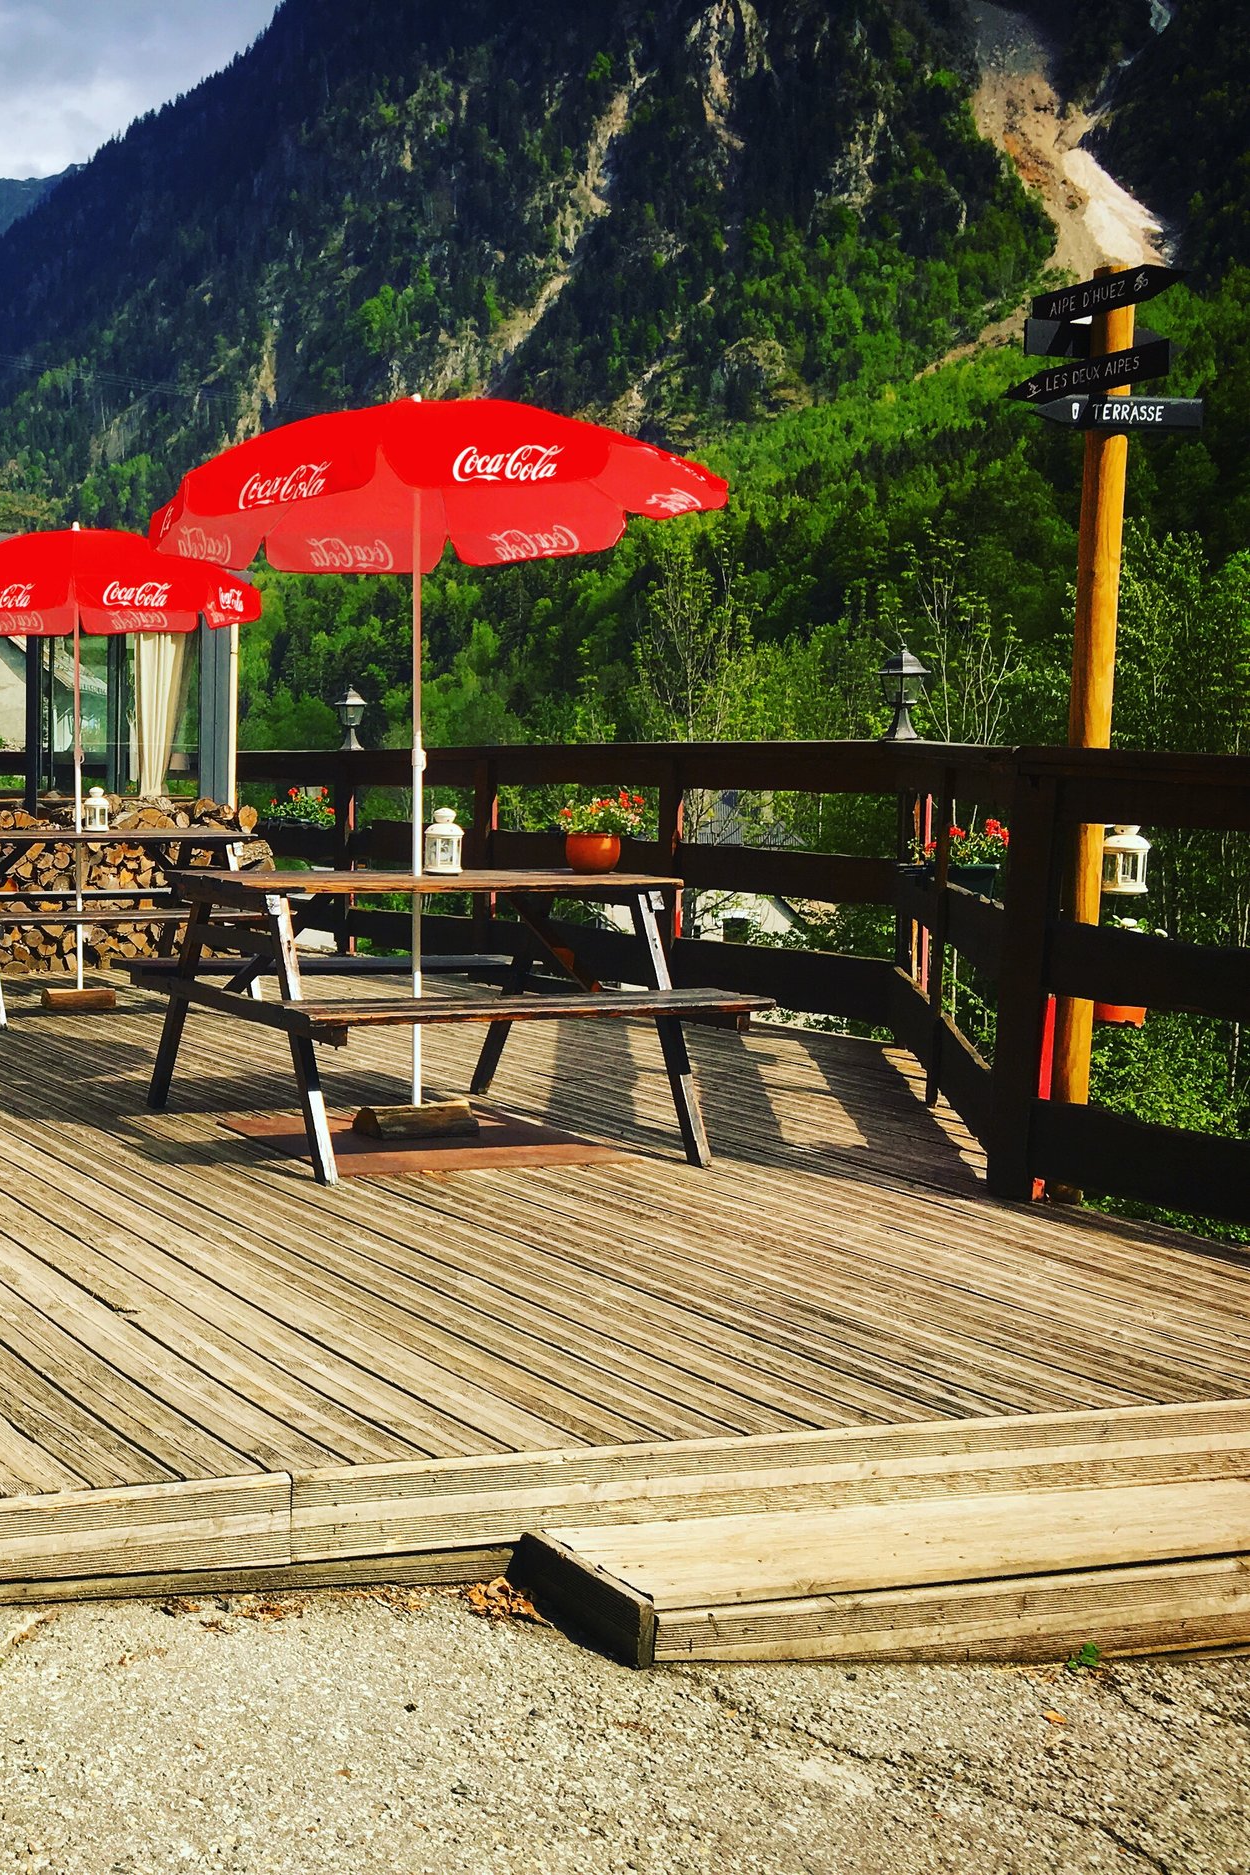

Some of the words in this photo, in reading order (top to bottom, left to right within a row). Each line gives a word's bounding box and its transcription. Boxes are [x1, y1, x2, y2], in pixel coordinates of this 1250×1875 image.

[1082, 280, 1126, 308] D'HUEZ
[1045, 372, 1068, 392] LES
[1072, 364, 1102, 385] DEUX
[1092, 403, 1165, 422] TERRASSE
[452, 444, 566, 483] Coca-Cola
[238, 461, 332, 510] Coca-Cola
[102, 580, 173, 607] Coca-Cola
